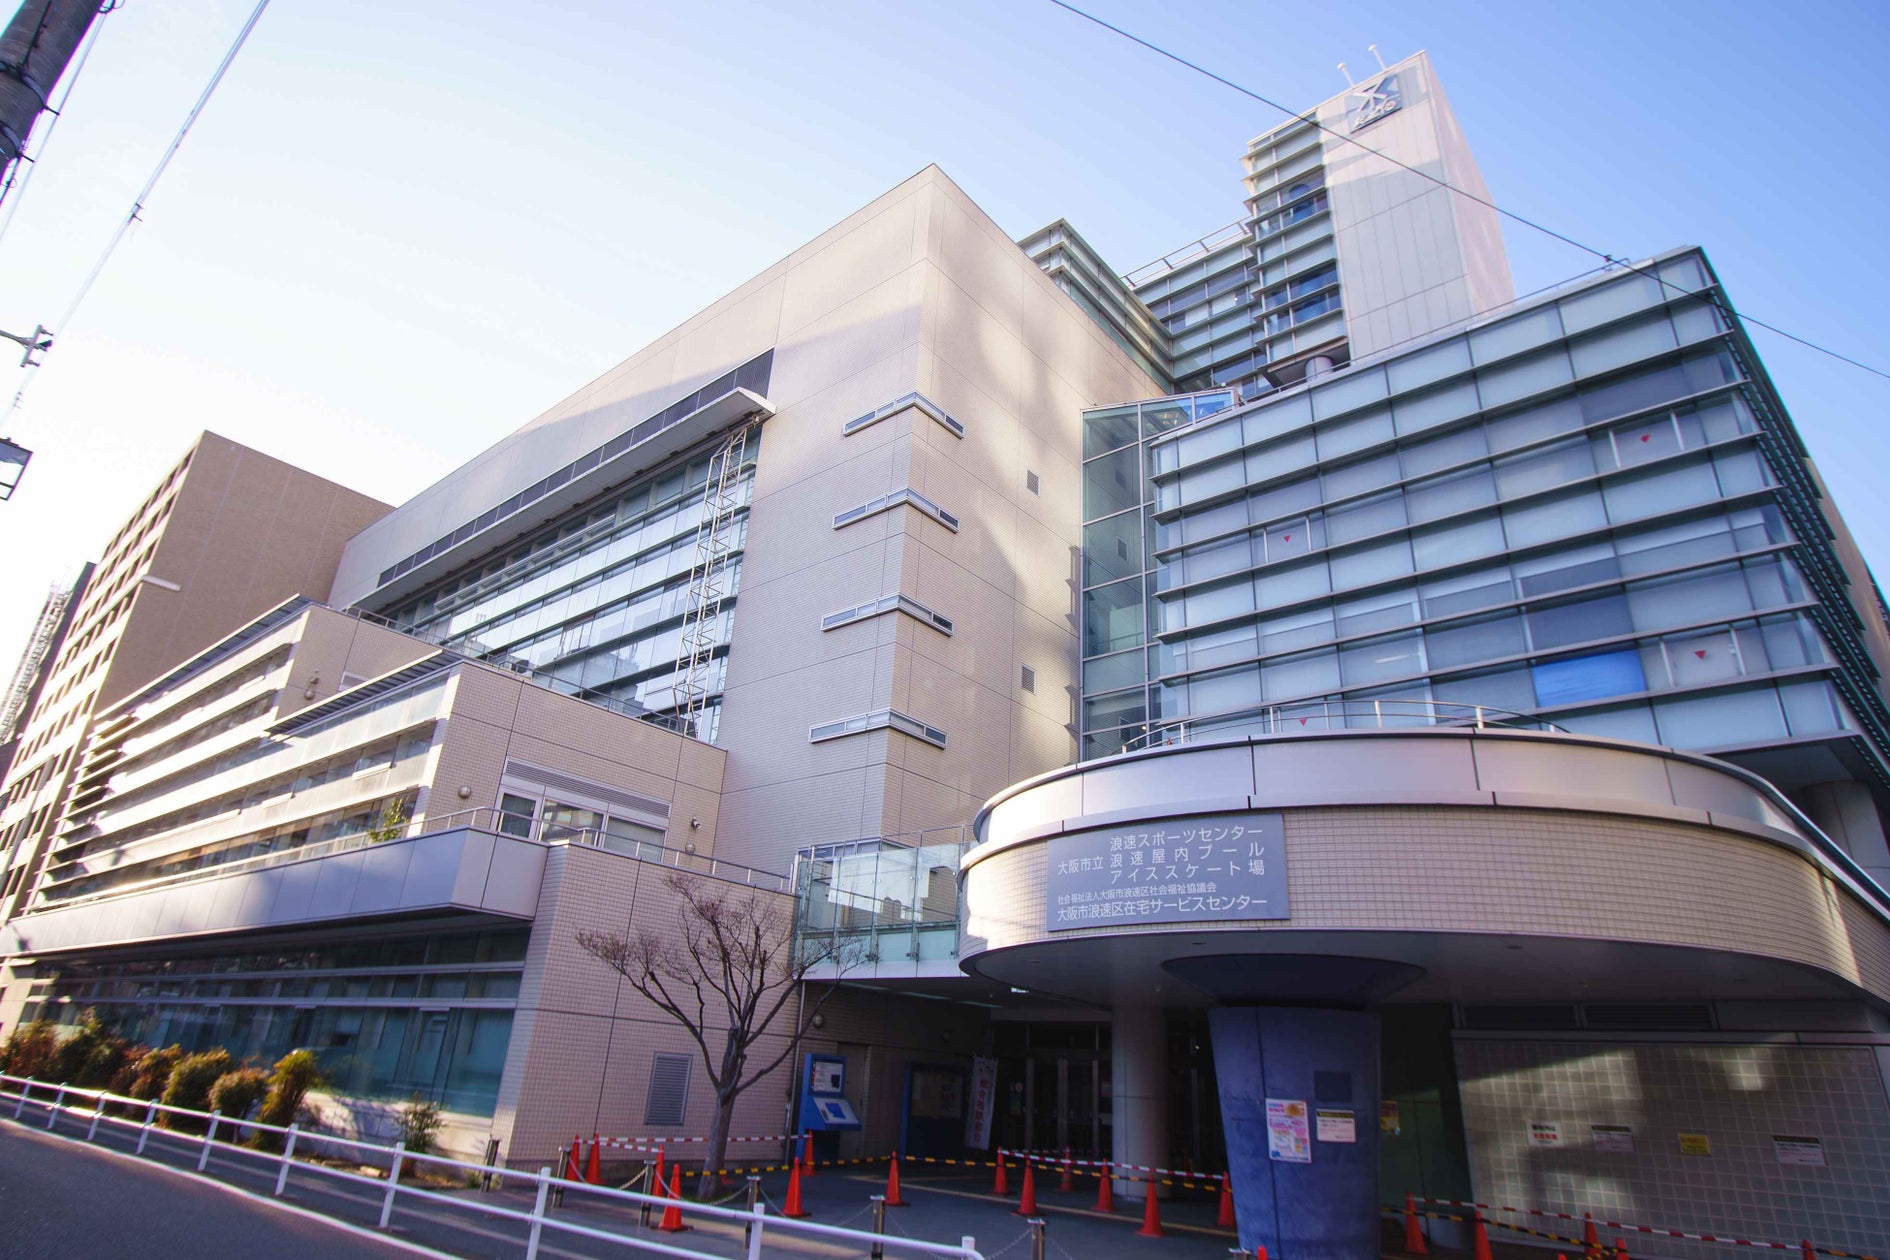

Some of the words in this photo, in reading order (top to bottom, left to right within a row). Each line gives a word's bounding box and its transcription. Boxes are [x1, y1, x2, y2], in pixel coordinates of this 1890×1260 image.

[1110, 825, 1263, 851] 浪速スポーツセンター
[1057, 855, 1104, 876] 大阪市立
[1110, 842, 1265, 868] 浪速屋内プール
[1110, 859, 1265, 885] アイススケート場
[1057, 895, 1268, 922] 大阪市浪速区在宅サービスセンター
